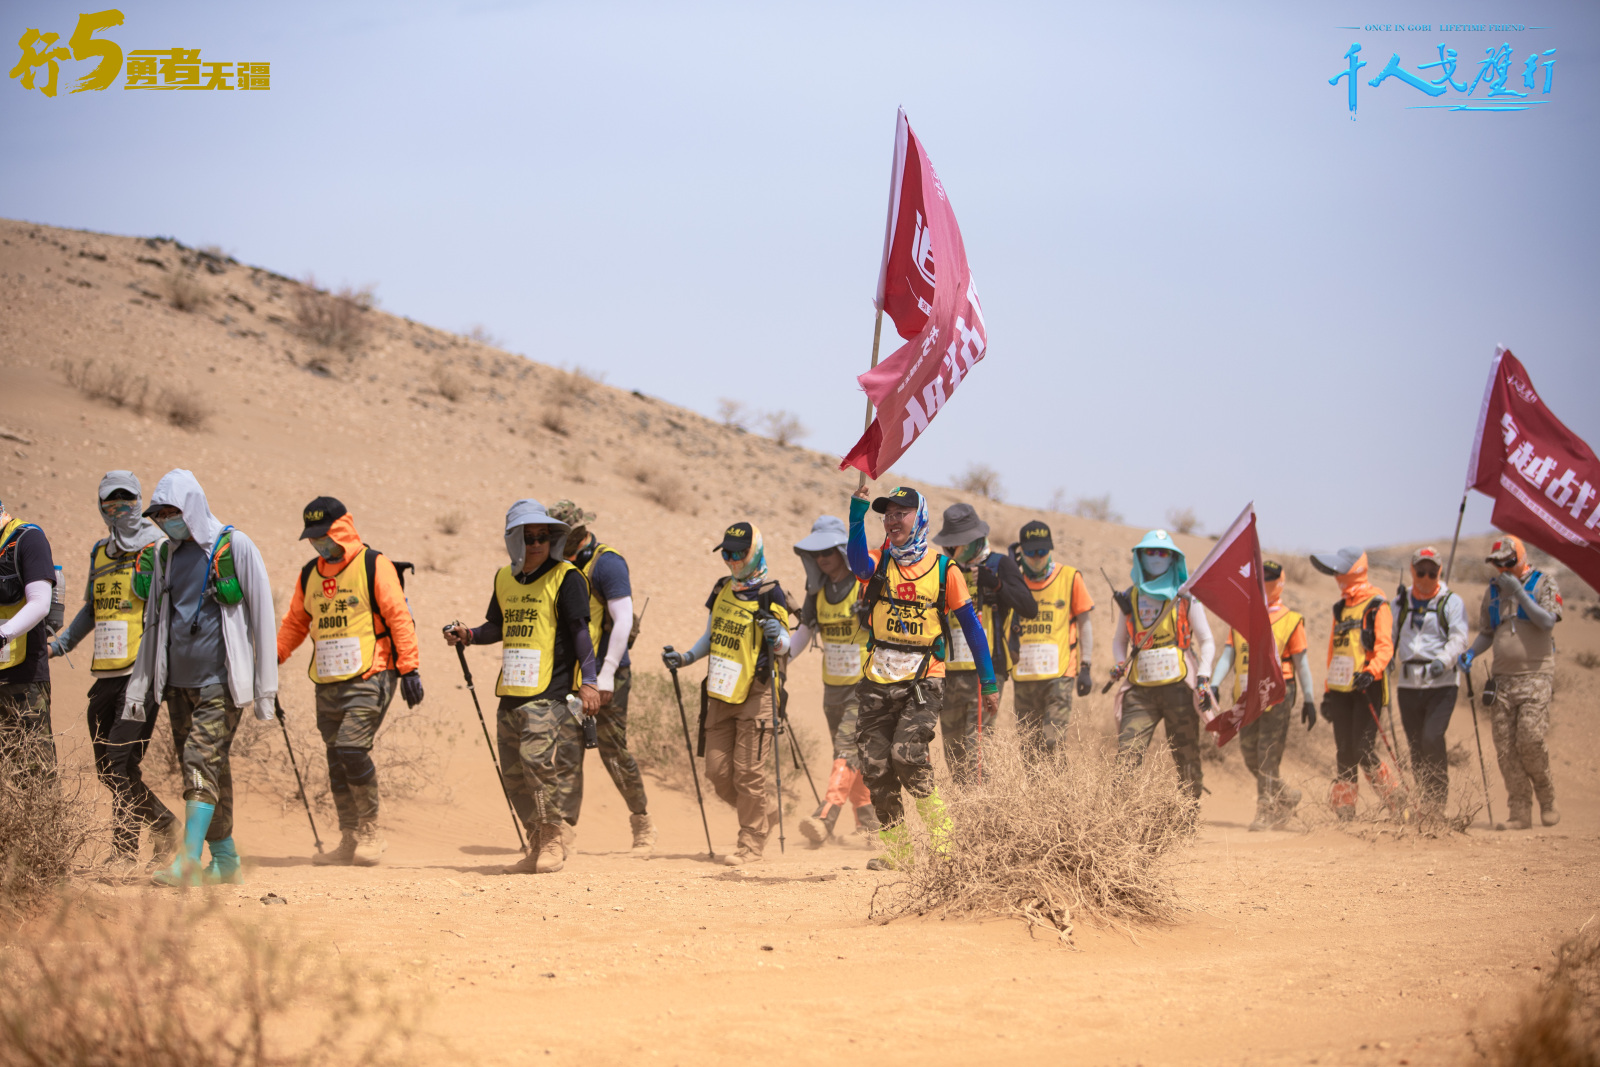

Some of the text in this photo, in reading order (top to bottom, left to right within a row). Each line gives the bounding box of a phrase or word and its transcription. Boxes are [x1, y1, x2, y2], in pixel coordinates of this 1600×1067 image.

[318, 616, 348, 629] A8001
[504, 608, 538, 623] 张建华
[506, 625, 534, 637] B8007
[886, 618, 924, 636] C8001
